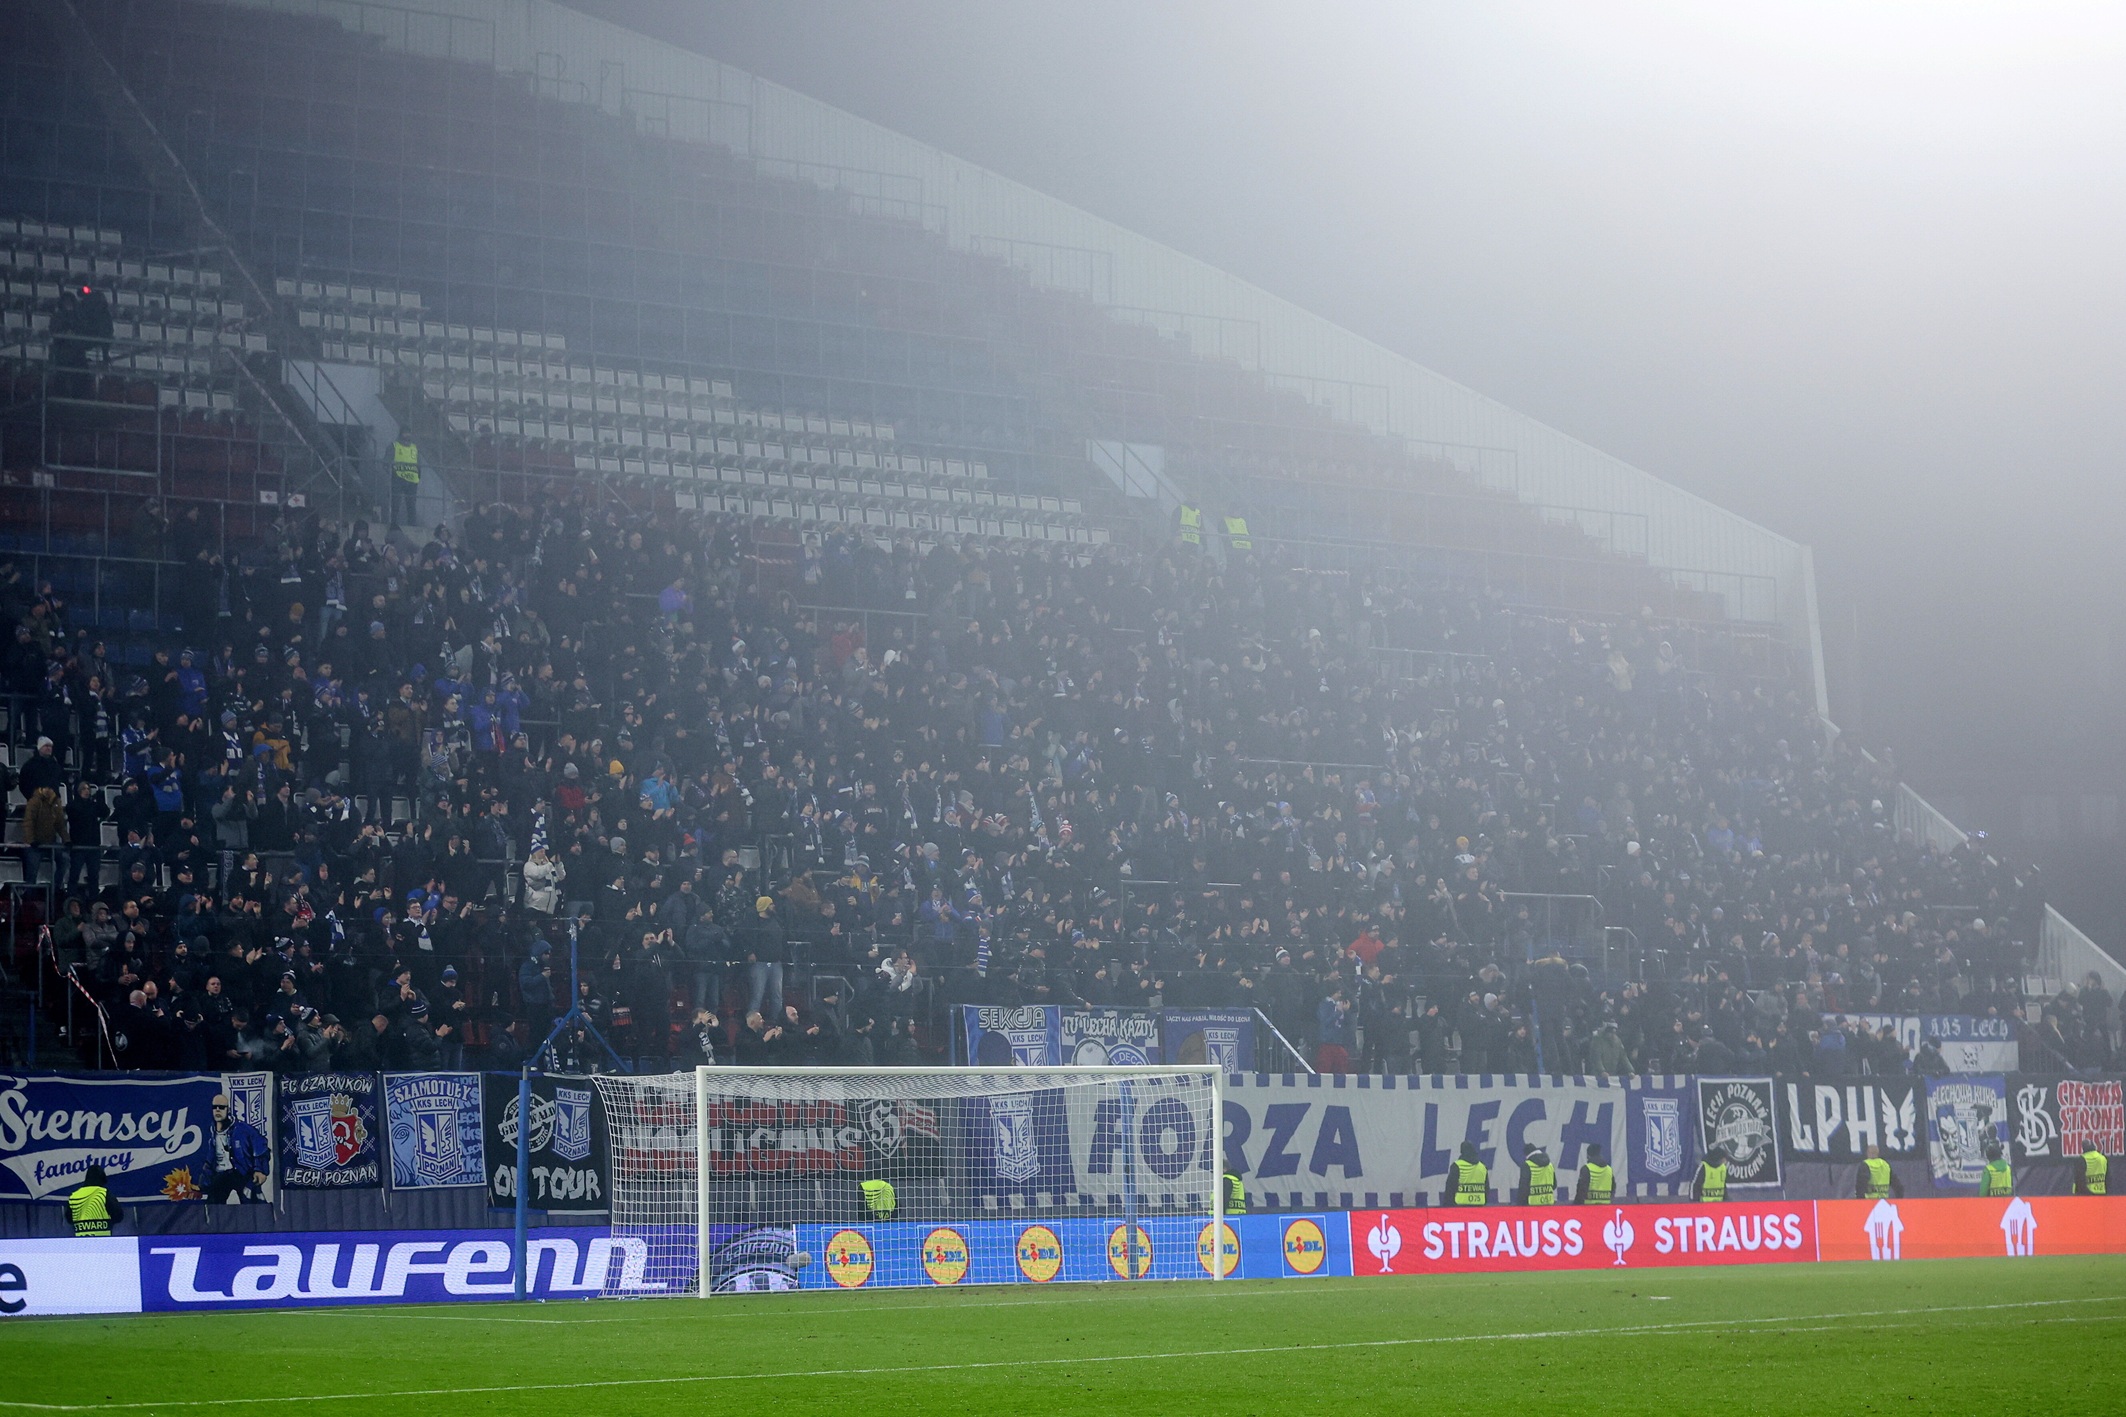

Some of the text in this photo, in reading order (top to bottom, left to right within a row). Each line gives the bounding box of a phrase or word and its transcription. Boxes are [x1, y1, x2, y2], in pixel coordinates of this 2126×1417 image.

[979, 1007, 1045, 1030] SEKCJA
[1063, 1016, 1079, 1036] TU
[1083, 1016, 1117, 1038] LECHA
[1027, 1034, 1043, 1042] LECH
[1220, 1031, 1234, 1039] LECH
[281, 1076, 373, 1093] FC CZARNKÓW
[394, 1079, 471, 1103] SZAMOTUŁY
[558, 1090, 571, 1098] KKS
[2057, 1080, 2123, 1106] CIEMNA
[297, 1100, 328, 1111] KKS LECH
[417, 1099, 452, 1108] KKS LECH
[1706, 1090, 1724, 1128] LECH
[0, 1076, 196, 1153] Śremscy
[501, 1106, 555, 1136] GRWALD
[2059, 1104, 2125, 1132] STRONA
[1087, 1097, 1614, 1180] FORZA LECH
[286, 1169, 320, 1184] LECH
[531, 1165, 601, 1200] TOUR
[1458, 1184, 1485, 1192] STEWAR
[1530, 1186, 1554, 1194] STEWA
[1422, 1219, 1584, 1260] STRAUSS
[1654, 1213, 1802, 1254] STRAUSS
[925, 1245, 965, 1264] LIDL
[1019, 1243, 1059, 1262] LIDL
[1111, 1241, 1149, 1260] LIL
[1286, 1236, 1322, 1255] LIDL
[829, 1247, 870, 1266] LIDL
